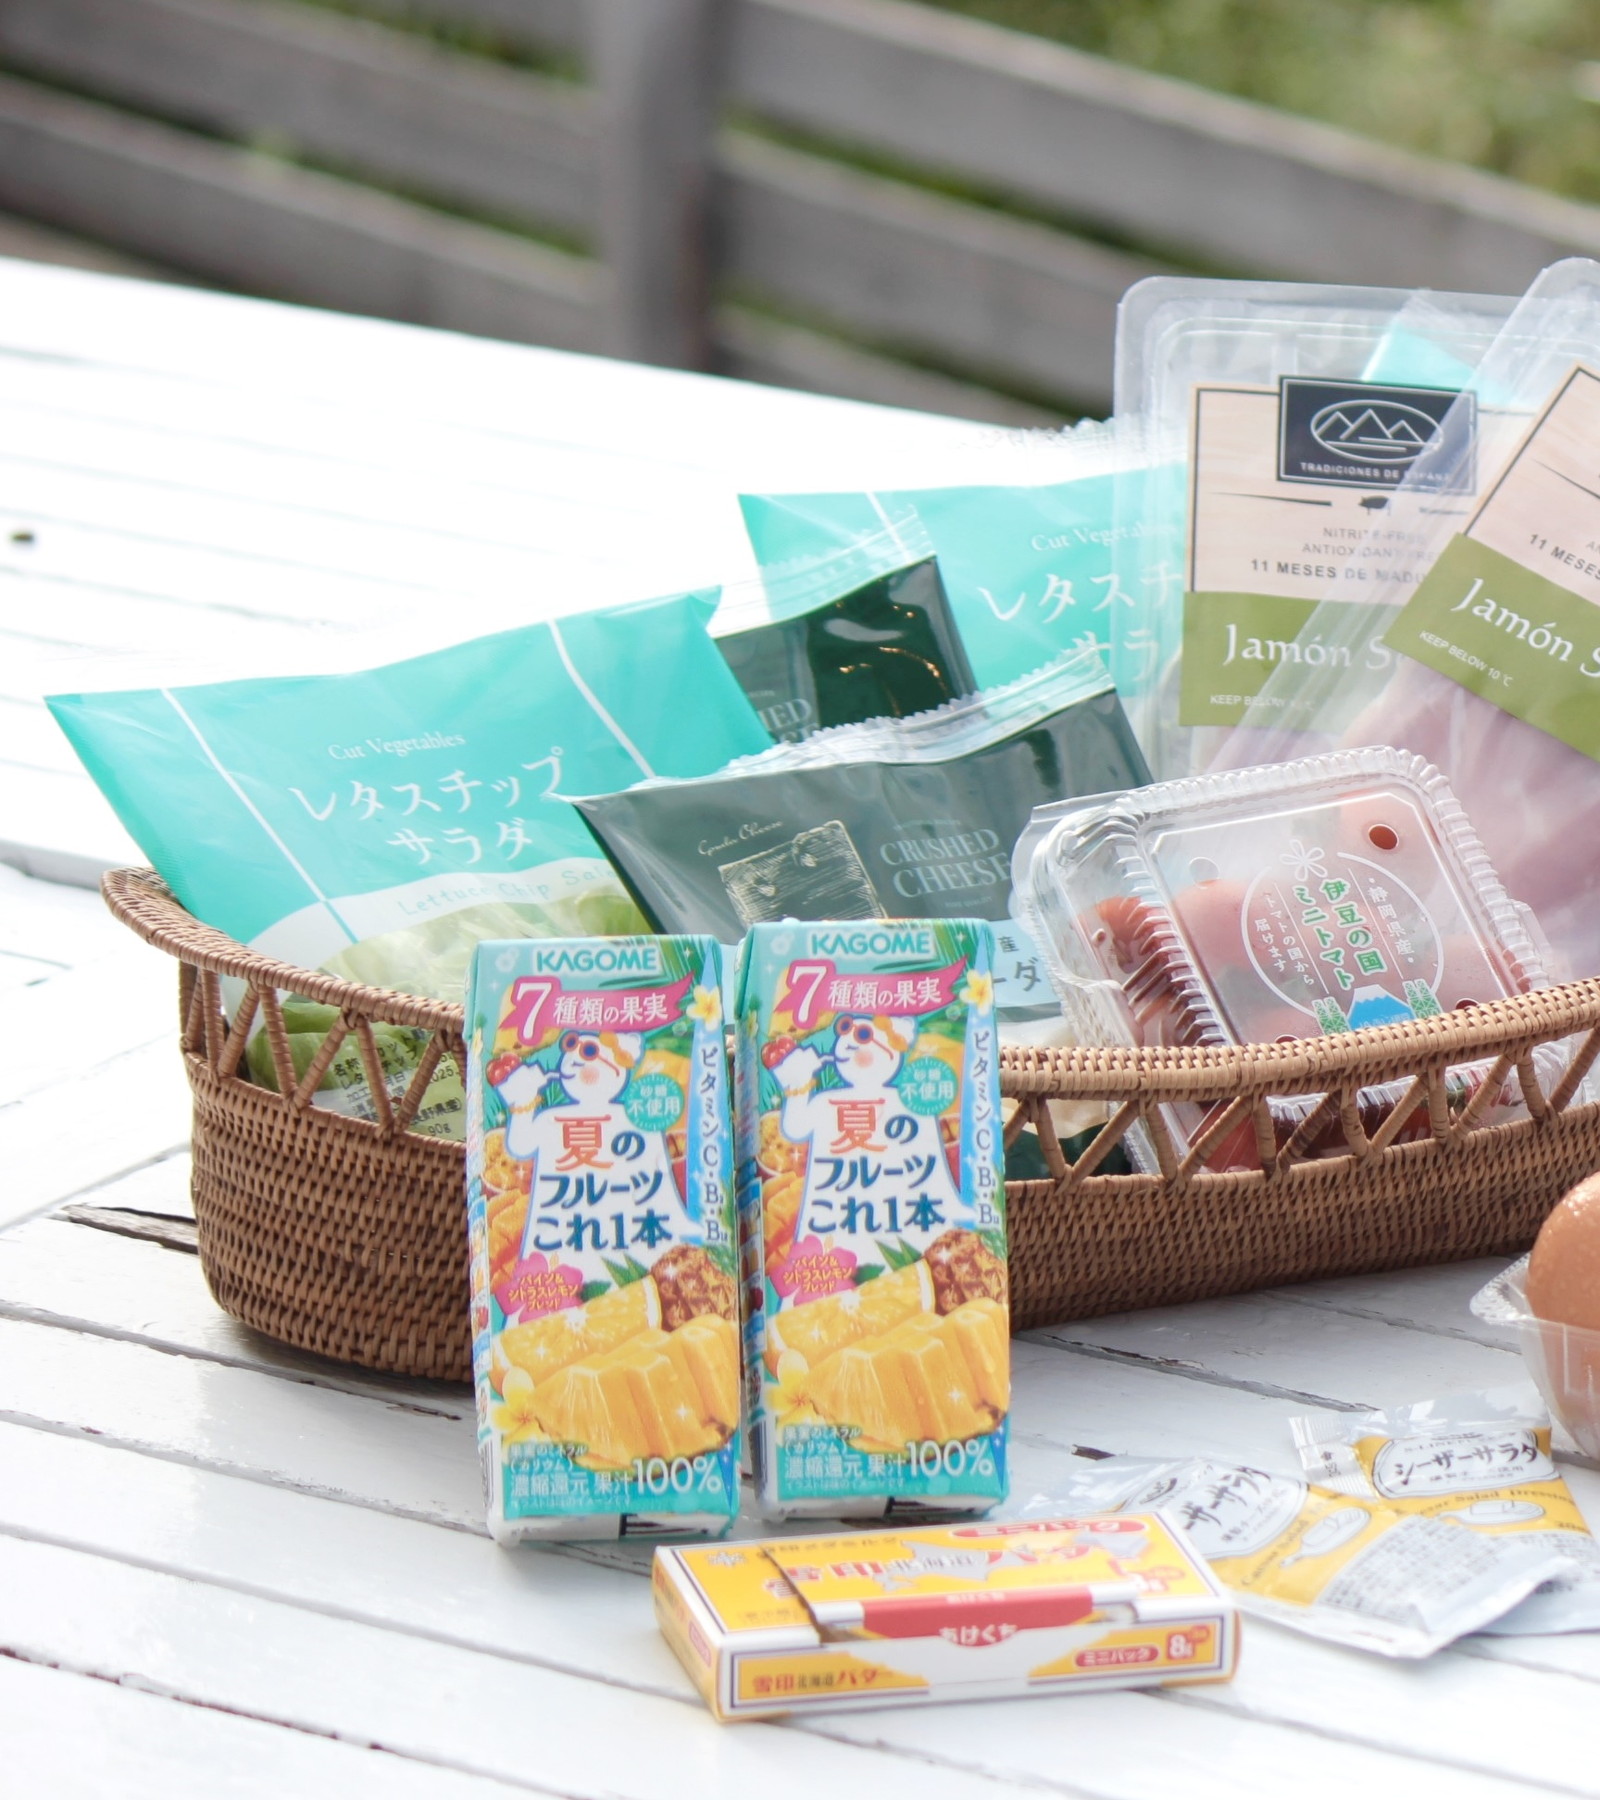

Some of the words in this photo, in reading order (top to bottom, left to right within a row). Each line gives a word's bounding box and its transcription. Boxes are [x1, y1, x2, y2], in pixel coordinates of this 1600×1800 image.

[1300, 462, 1380, 478] TRADICIONES
[1384, 469, 1399, 479] DE
[1031, 534, 1071, 551] Cut
[1529, 533, 1547, 550] 11
[1251, 559, 1268, 573] 11
[1277, 563, 1336, 579] MESES
[1345, 567, 1367, 580] DE
[1451, 578, 1574, 661] Jamón
[1223, 624, 1352, 667] Jamón
[1419, 630, 1449, 650] KEEP
[1448, 645, 1487, 672] BELOW
[1488, 666, 1500, 679] 10
[1210, 694, 1241, 706] KEEP
[328, 744, 362, 760] Cut
[366, 731, 466, 758] Vegetables
[288, 746, 564, 821] レタスチップ
[386, 817, 532, 865] サラダ
[880, 828, 1000, 866] CRUSHED
[893, 853, 1011, 898] CHEESE
[497, 881, 549, 902] Chip
[1263, 893, 1315, 985] トマトの国から
[1293, 885, 1354, 990] ミニトマト
[1320, 878, 1387, 975] 伊豆の国
[811, 932, 929, 955] KAGOME
[1254, 918, 1287, 972] 届けます
[537, 949, 657, 971] KAGOME
[902, 1082, 954, 1100] 不使用
[628, 1098, 681, 1116] 不使用
[828, 1098, 918, 1154] 夏の
[554, 1114, 646, 1171] 夏の
[814, 1154, 936, 1191] フルーツ
[539, 1170, 663, 1209] フルーツ
[808, 1192, 945, 1234] これ1本
[533, 1209, 673, 1252] これ1本
[783, 1267, 852, 1284] シトラスレモン
[802, 1280, 836, 1293] ブレンド
[508, 1283, 578, 1304] シトラスレモン
[527, 1298, 561, 1311] ブレンド
[786, 1454, 863, 1478] 濃縮還元
[511, 1472, 589, 1497] 濃縮還元
[1084, 1647, 1151, 1665] ミニパック
